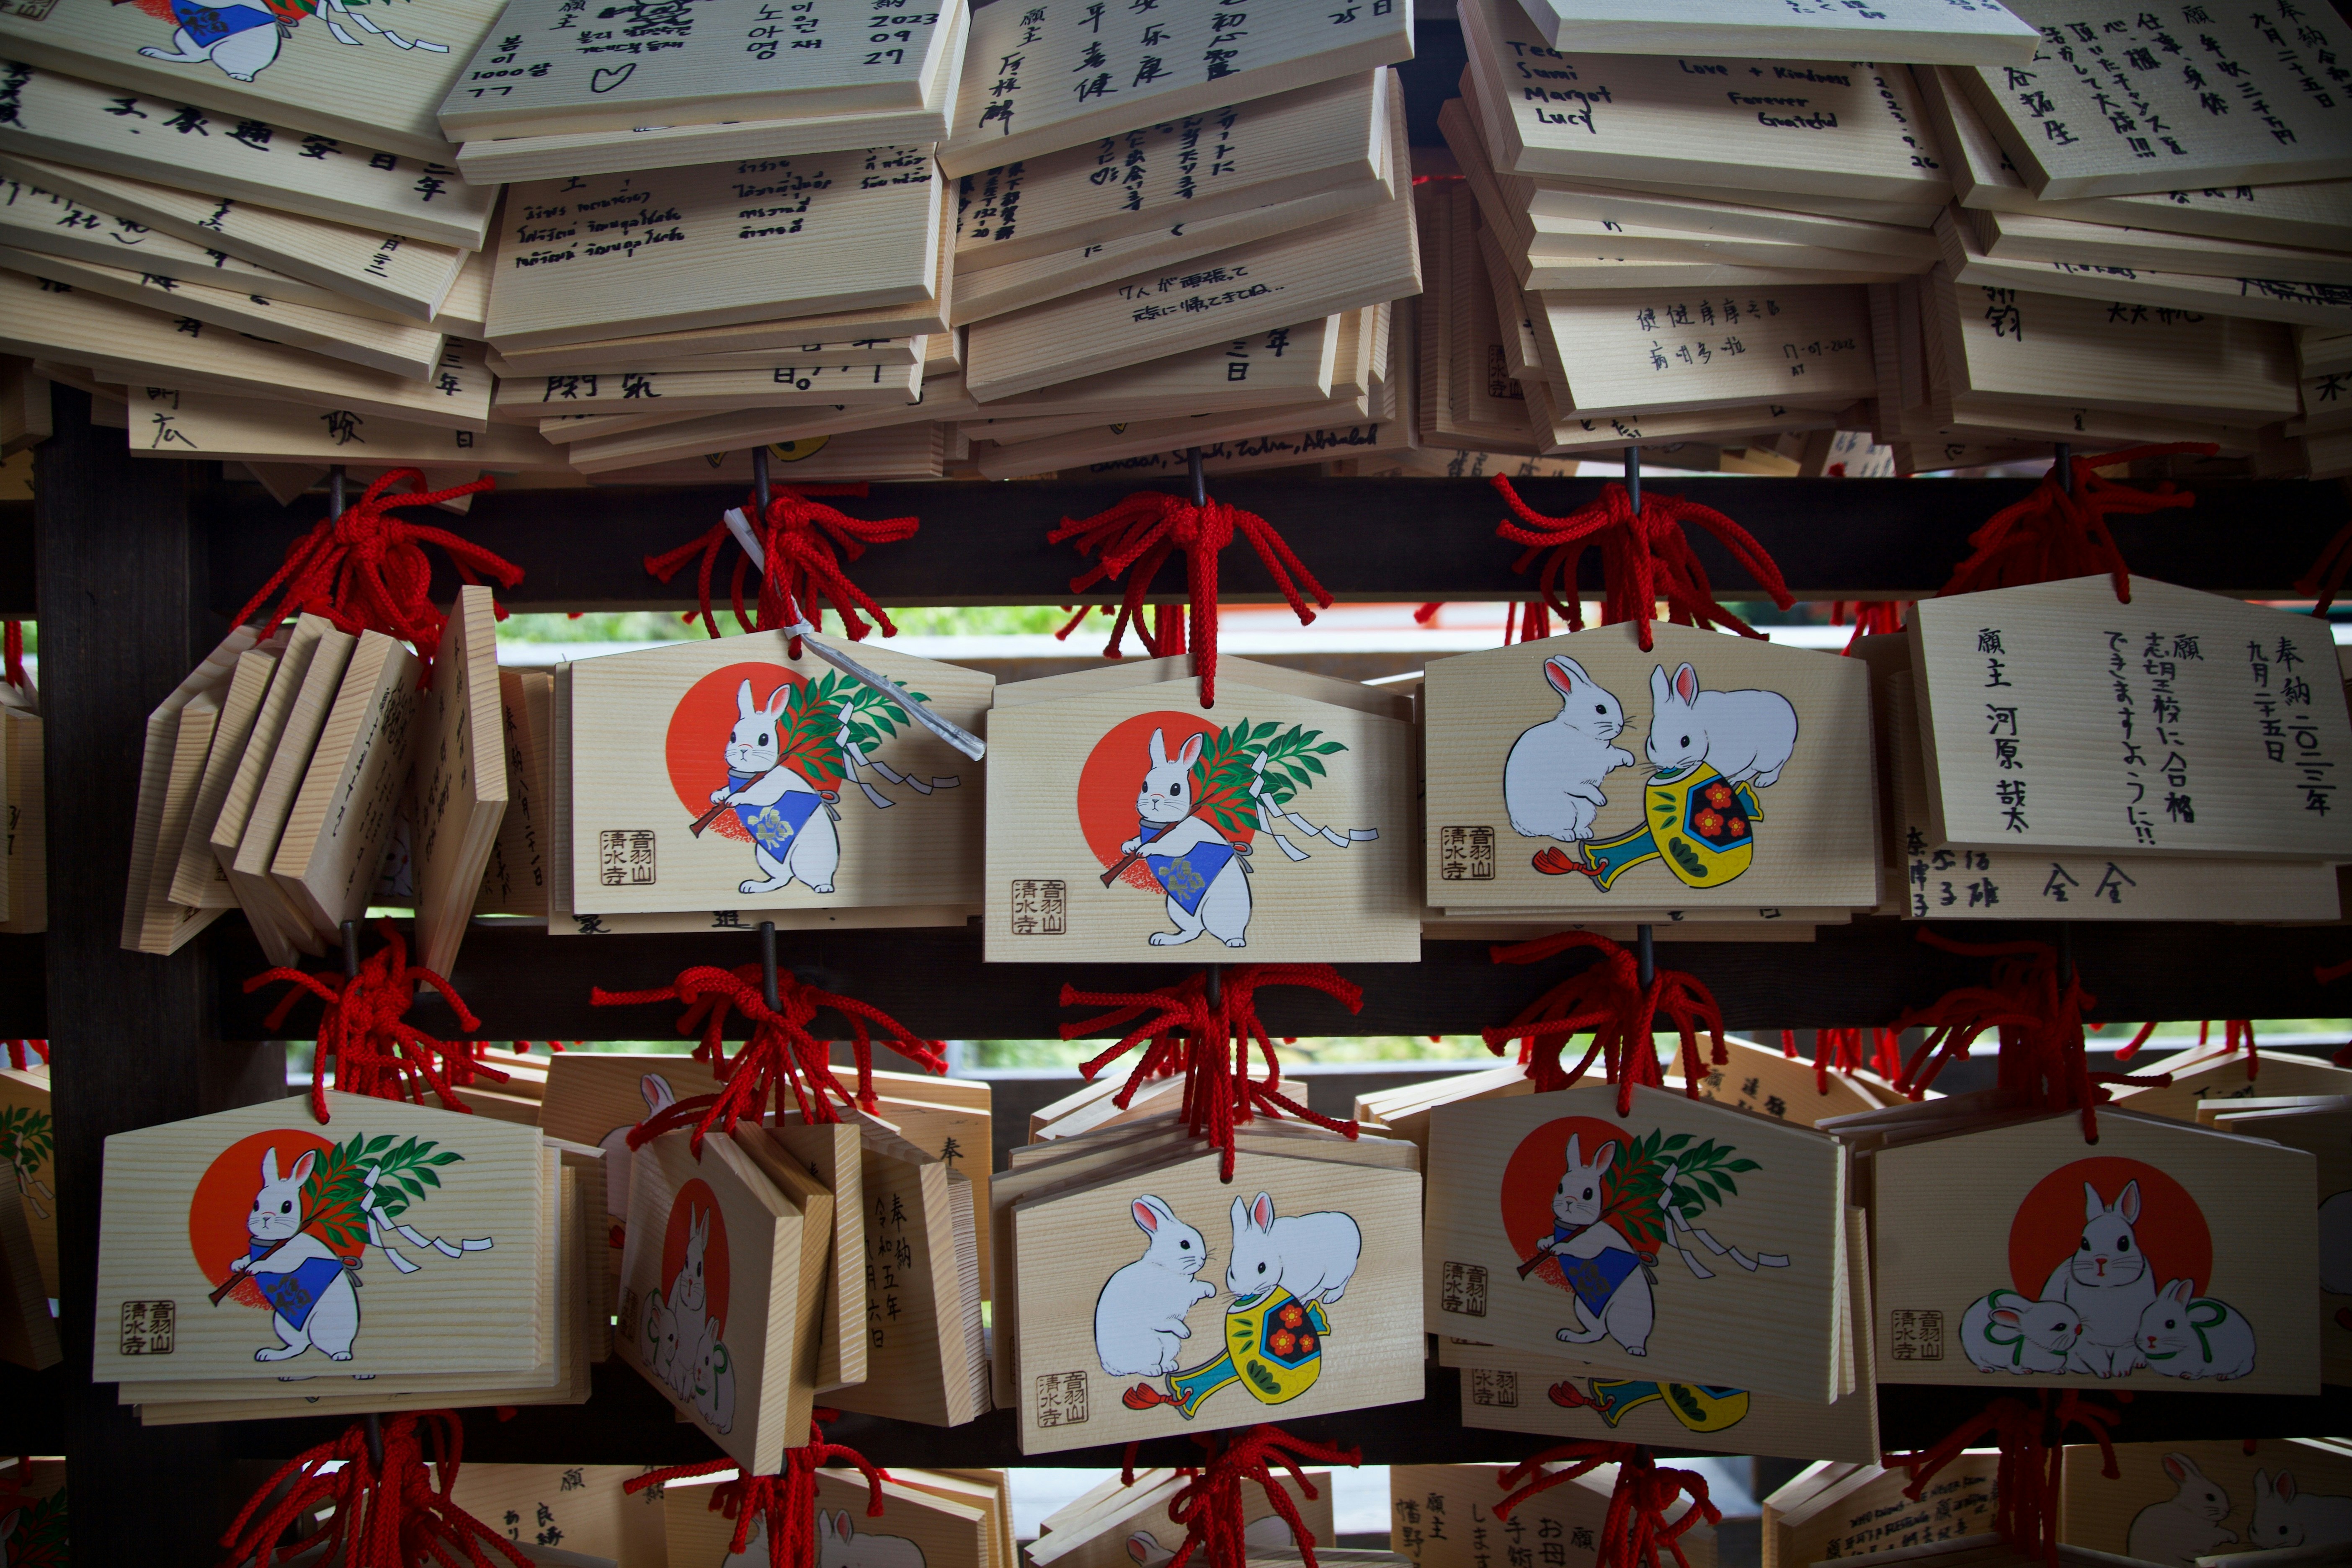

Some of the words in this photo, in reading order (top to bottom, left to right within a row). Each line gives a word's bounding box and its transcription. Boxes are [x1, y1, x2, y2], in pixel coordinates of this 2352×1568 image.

[867, 13, 940, 28] 2023
[870, 30, 912, 42] 09
[863, 49, 904, 64] 27
[1679, 60, 1728, 76] Love
[1524, 86, 1612, 113] Margot
[1728, 92, 1809, 106] Forever
[1535, 108, 1596, 134] Lucy
[1977, 628, 2012, 688] 願主
